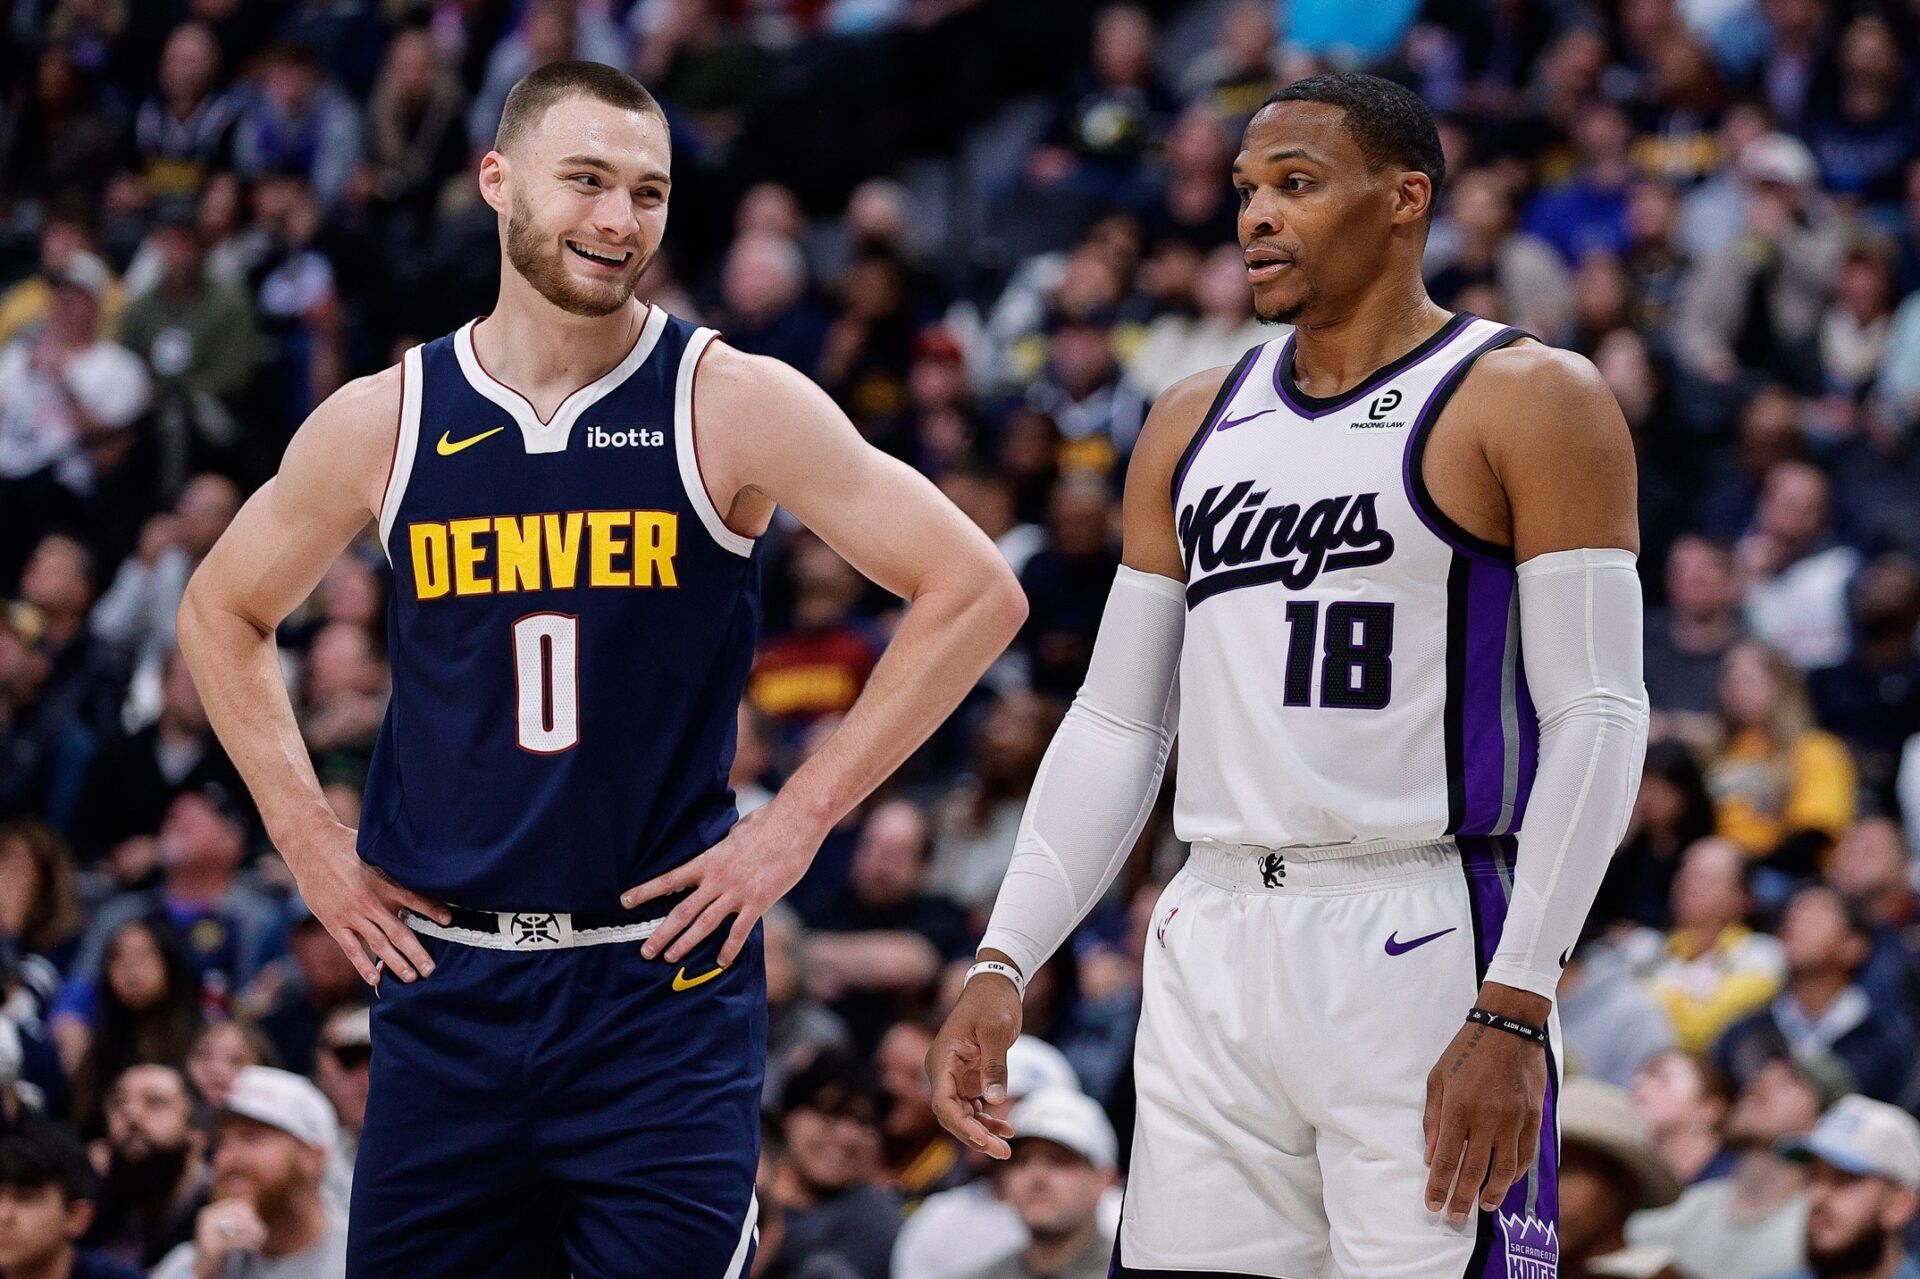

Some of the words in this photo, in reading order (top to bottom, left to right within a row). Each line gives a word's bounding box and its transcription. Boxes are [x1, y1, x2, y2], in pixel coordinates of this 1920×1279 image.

[587, 426, 664, 447] ibotta
[408, 509, 679, 600] DENVER
[1178, 479, 1395, 612] Kings
[511, 610, 580, 756] 0
[1283, 600, 1395, 710] 18
[1510, 1243, 1556, 1262] SACRAMENTO
